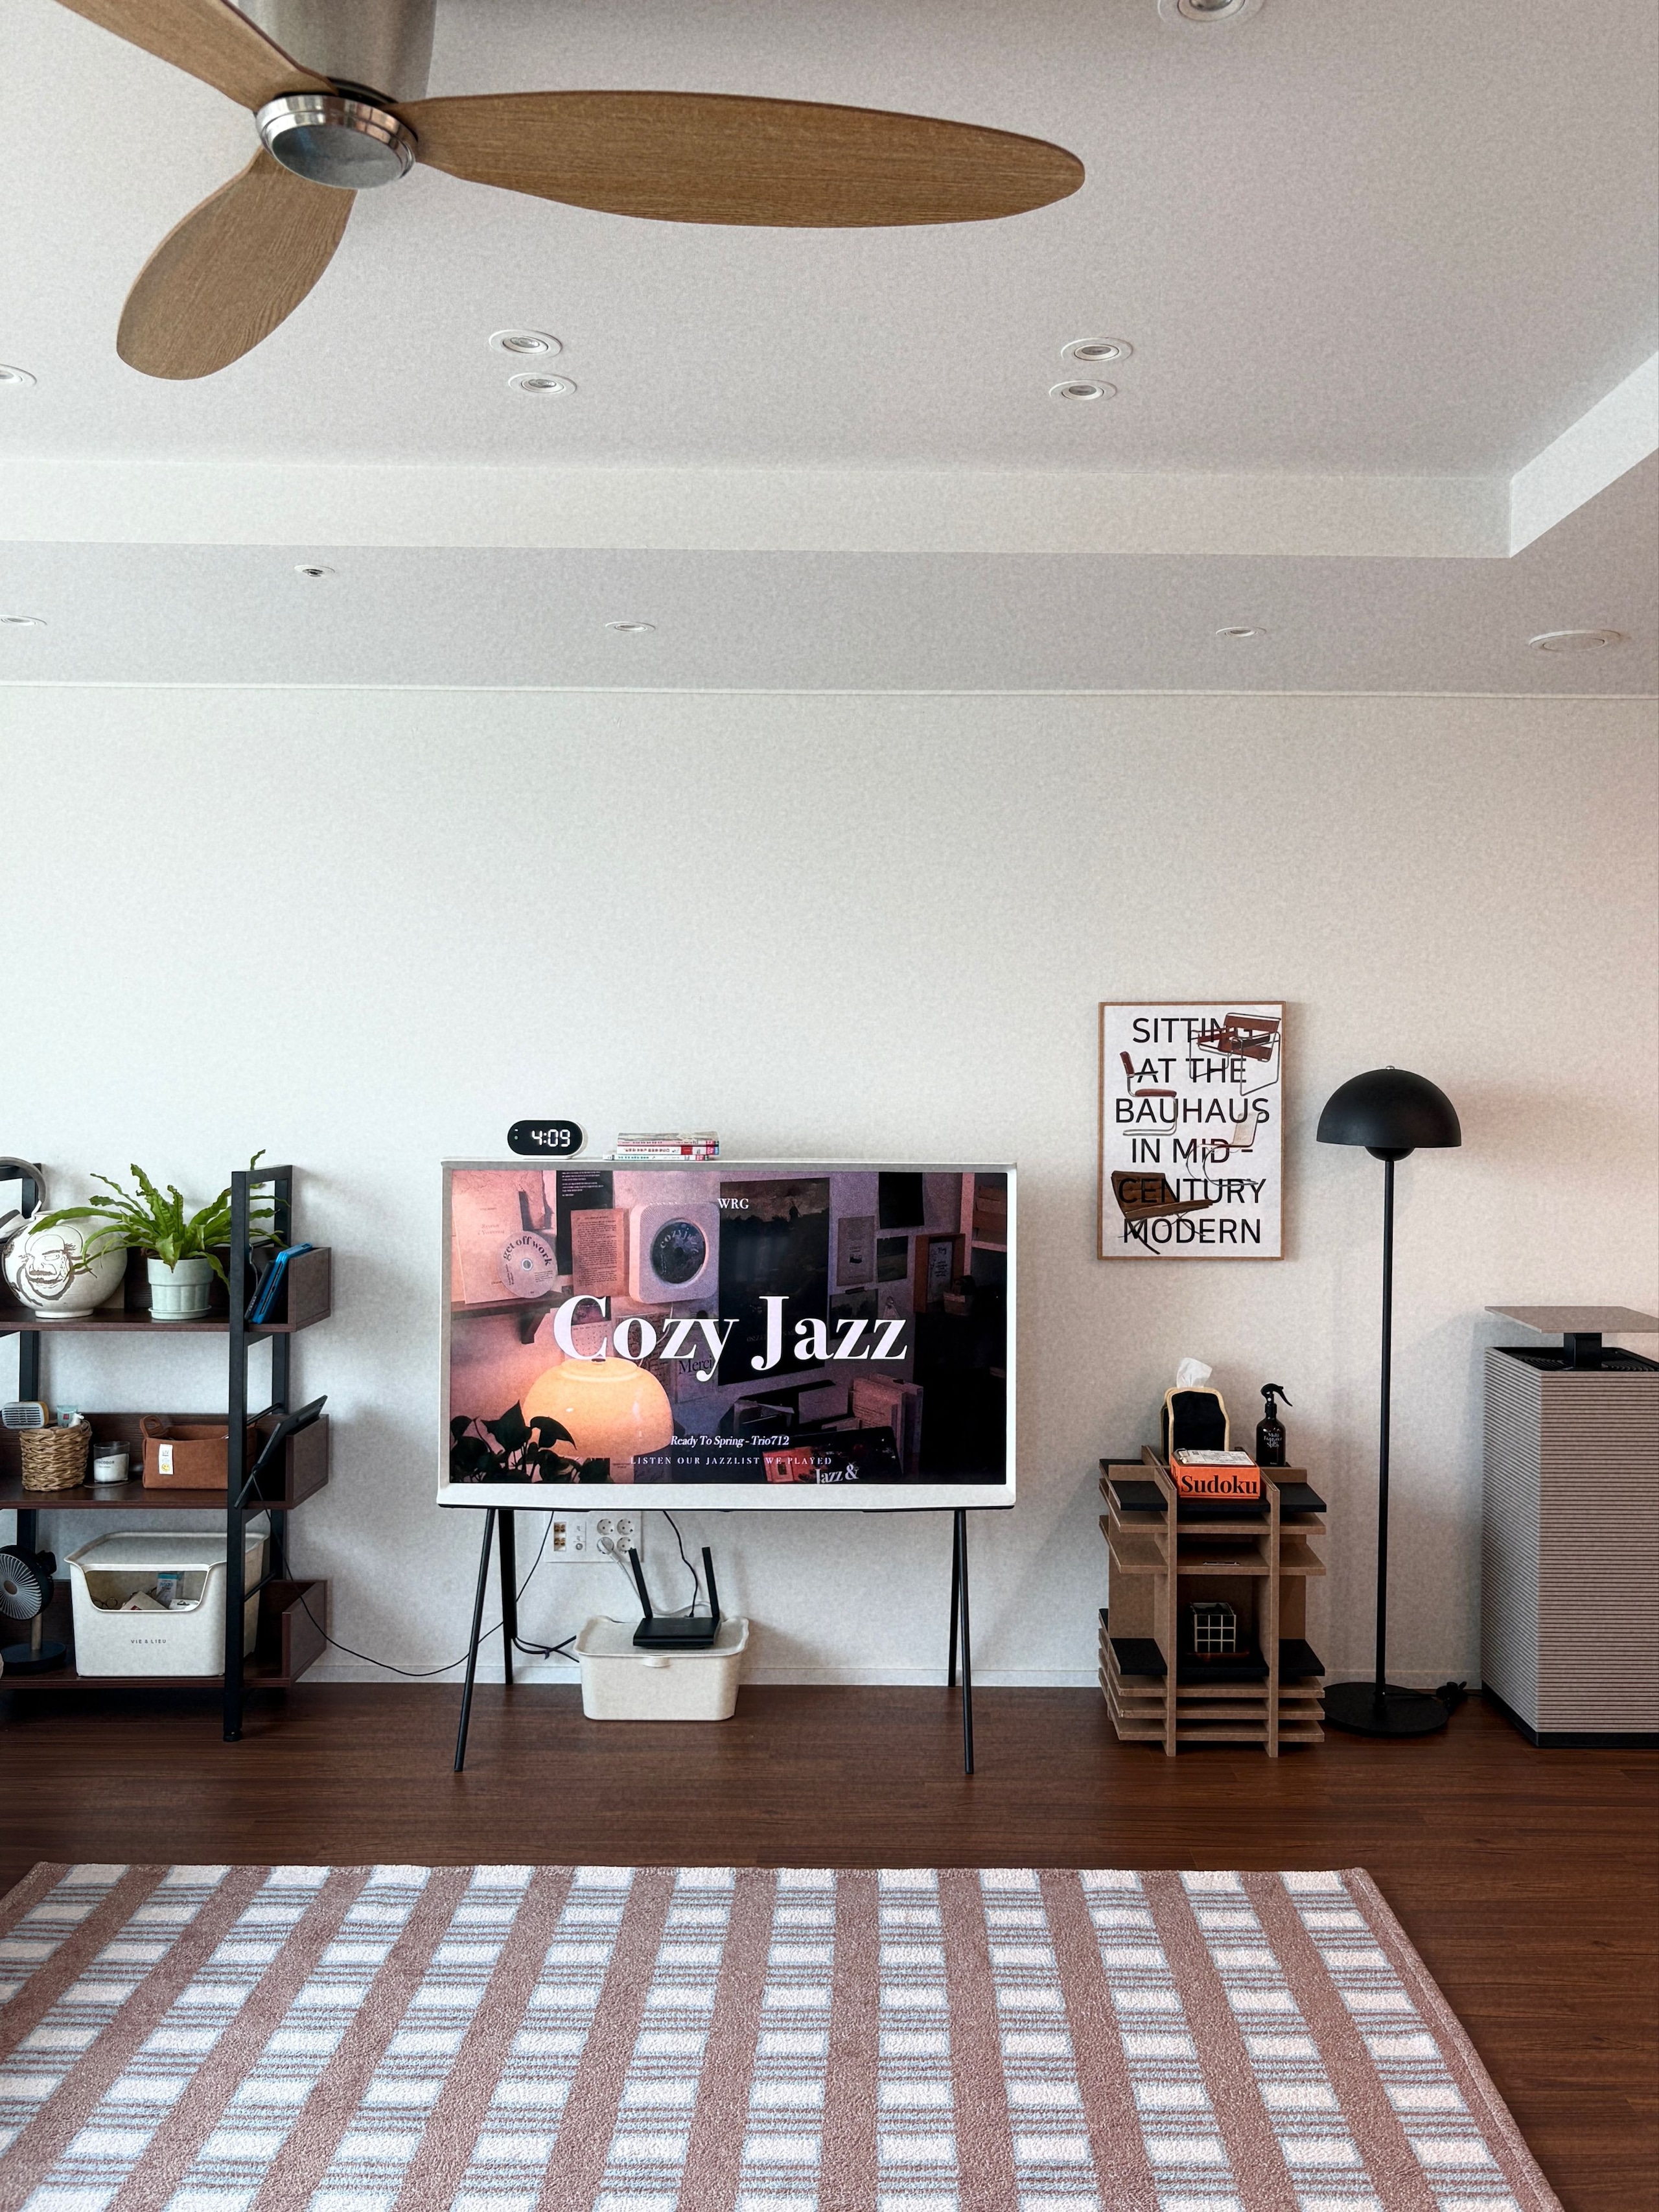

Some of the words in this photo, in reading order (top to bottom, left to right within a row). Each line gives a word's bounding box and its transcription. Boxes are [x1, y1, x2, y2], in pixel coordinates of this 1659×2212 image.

[1137, 1058, 1176, 1083] AT
[1186, 1058, 1247, 1083] THE
[1116, 1098, 1270, 1123] BAUHAUS
[531, 1128, 571, 1147] 4:09
[1132, 1139, 1160, 1163] IN
[717, 1198, 749, 1209] WRG
[1119, 1179, 1266, 1204] CENTURY
[1124, 1218, 1260, 1244] MODERN
[503, 1242, 515, 1261] get
[516, 1235, 532, 1246] off
[533, 1240, 552, 1266] work
[553, 1294, 740, 1382] Cozy
[750, 1296, 908, 1371] Jazz
[670, 1435, 698, 1449] Ready
[699, 1435, 713, 1445] To
[713, 1435, 745, 1449] Spring
[751, 1435, 790, 1446] Trio712
[630, 1456, 672, 1465] LISTEN
[677, 1456, 701, 1465] OUR
[705, 1456, 760, 1465] JAZZLIST
[765, 1456, 782, 1465] WE
[787, 1456, 831, 1465] PLAYED
[815, 1468, 843, 1484] Jazz
[844, 1461, 859, 1480] &
[1181, 1474, 1258, 1494] Sudoku
